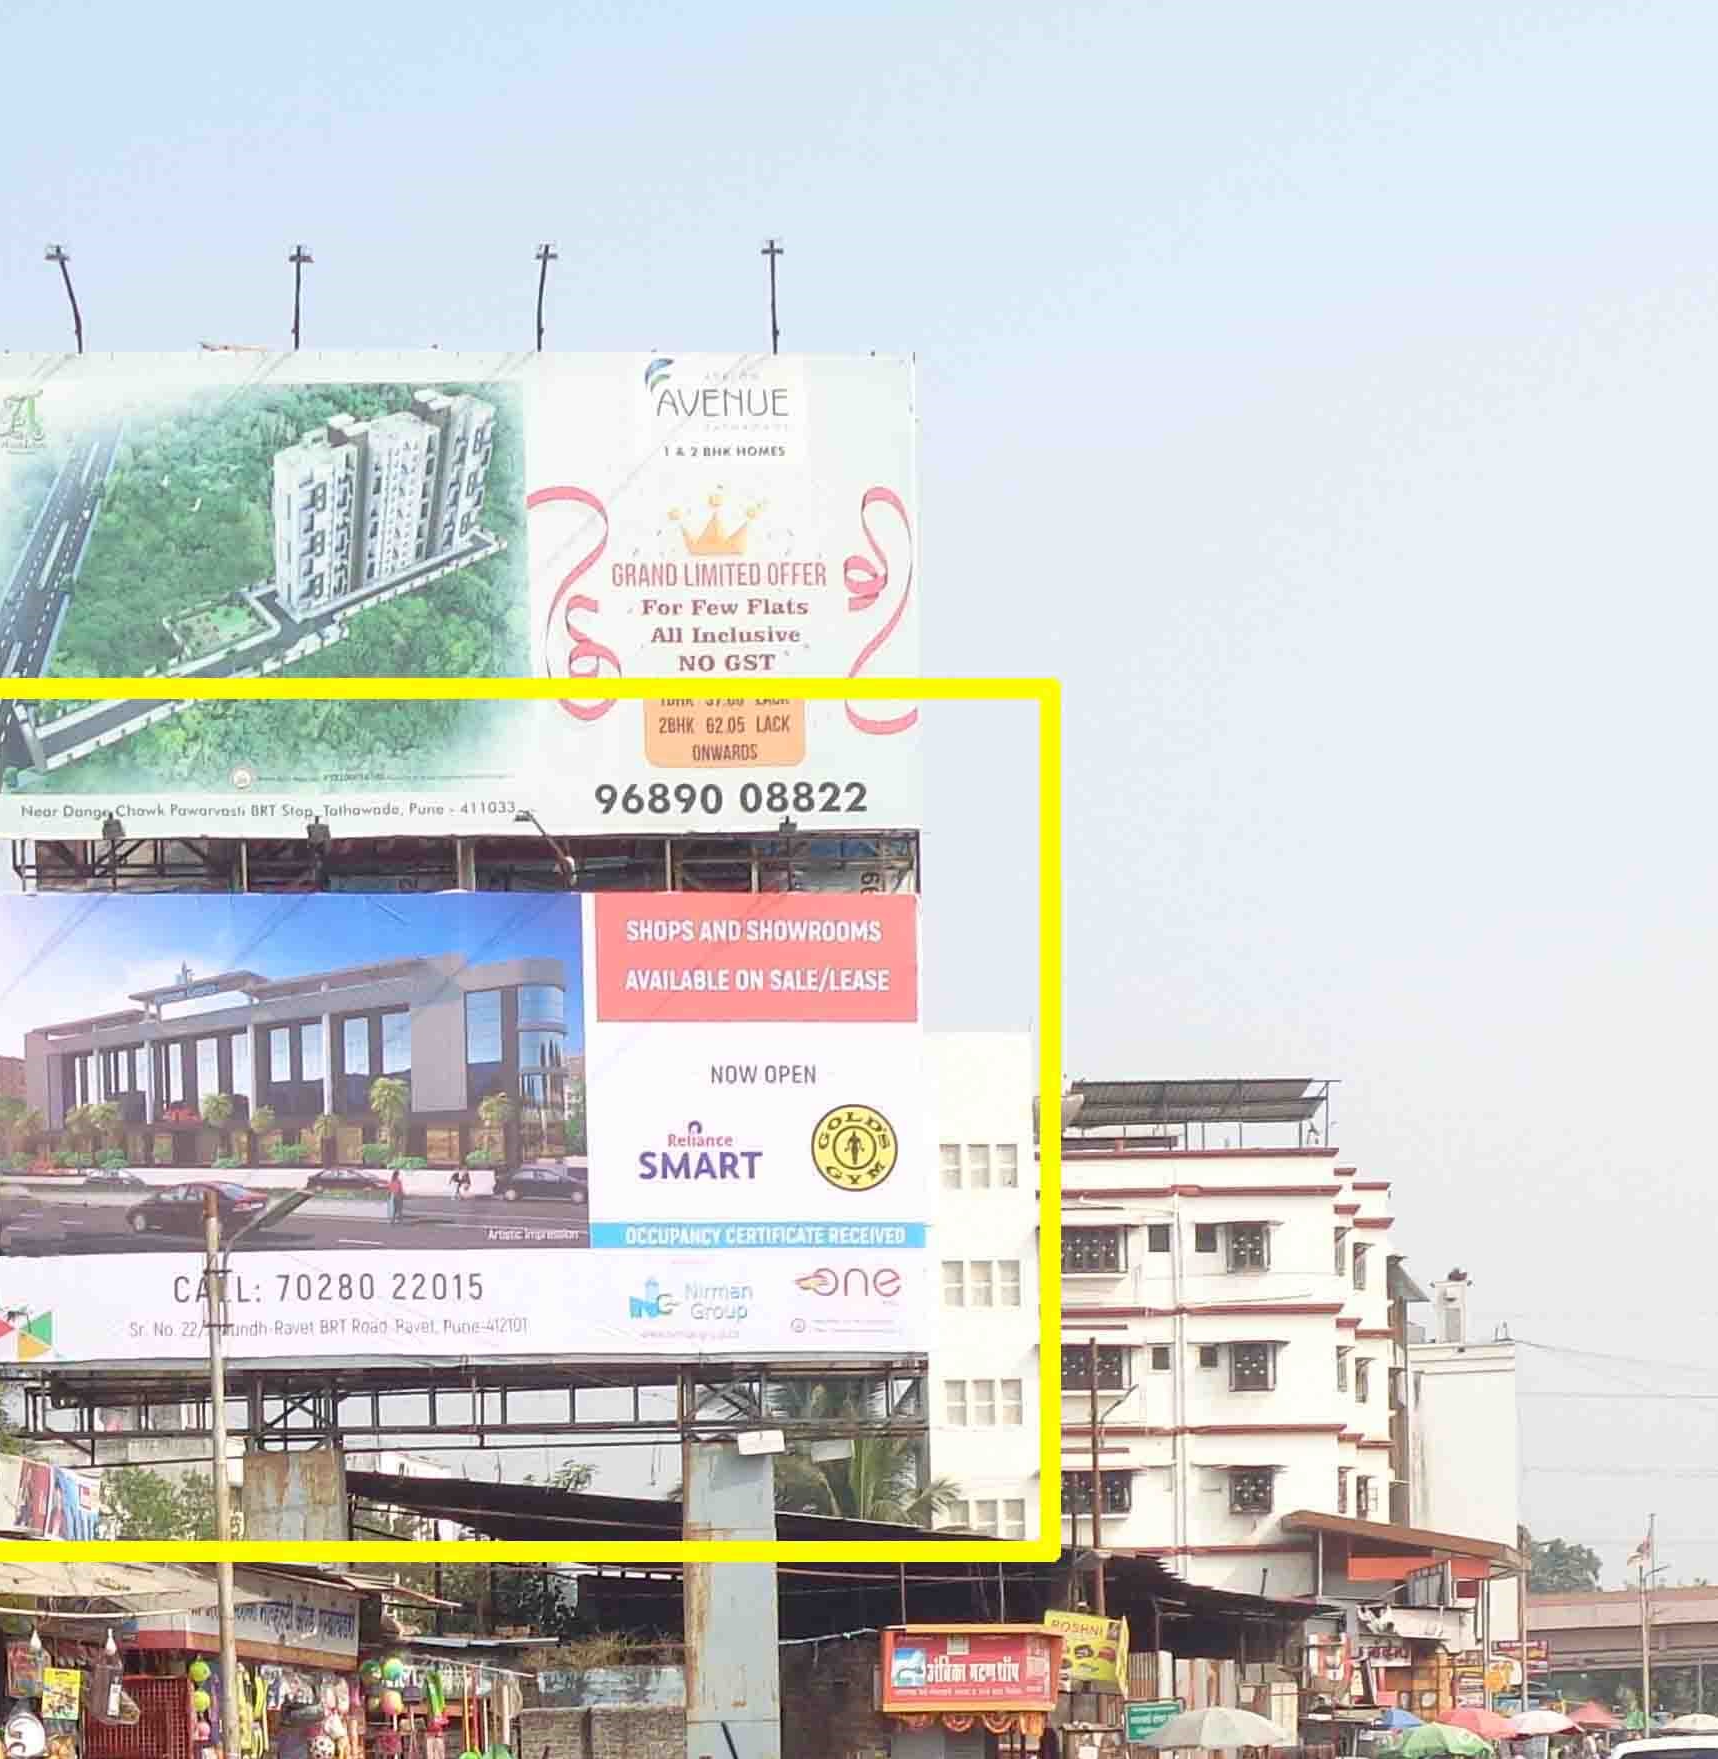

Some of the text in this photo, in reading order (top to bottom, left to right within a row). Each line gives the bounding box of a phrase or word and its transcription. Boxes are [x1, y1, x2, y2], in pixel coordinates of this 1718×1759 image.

[657, 387, 790, 417] AVENUE
[664, 446, 670, 457] 1
[691, 446, 699, 457] 2
[703, 446, 731, 457] BHK
[737, 446, 786, 457] HOMES
[611, 561, 828, 588] GRAND LIMITED OFFER
[641, 597, 810, 616] For Few Flats
[651, 626, 802, 644] All Inclusive
[678, 653, 777, 672] NO GST
[658, 717, 695, 735] 2BHK
[756, 715, 792, 734] LACK
[692, 744, 759, 763] ONWARDS
[594, 781, 869, 815] 96890 08822
[21, 804, 59, 819] Near
[115, 803, 166, 819] Chowk
[251, 803, 276, 818] BRT
[409, 802, 445, 817] Pune
[460, 801, 517, 816] 411033
[626, 919, 883, 943] SHOPS AND SHOWROOMS
[624, 966, 891, 993] AVAILABLE ON SALE/LEASE
[711, 1064, 817, 1085] NOW OPEN
[668, 1133, 733, 1148] Reliance
[817, 1110, 891, 1152] GOLD'S
[638, 1150, 763, 1180] SMART
[825, 1159, 887, 1187] GYM
[625, 1224, 907, 1246] OCCUPANCY CERTIFICATE RECEIVED
[173, 1272, 484, 1303] CAL: 70280 22015
[685, 1281, 753, 1300] Nirman
[690, 1303, 749, 1324] Group
[129, 1322, 150, 1338] Sr.
[320, 1319, 348, 1336] BRT
